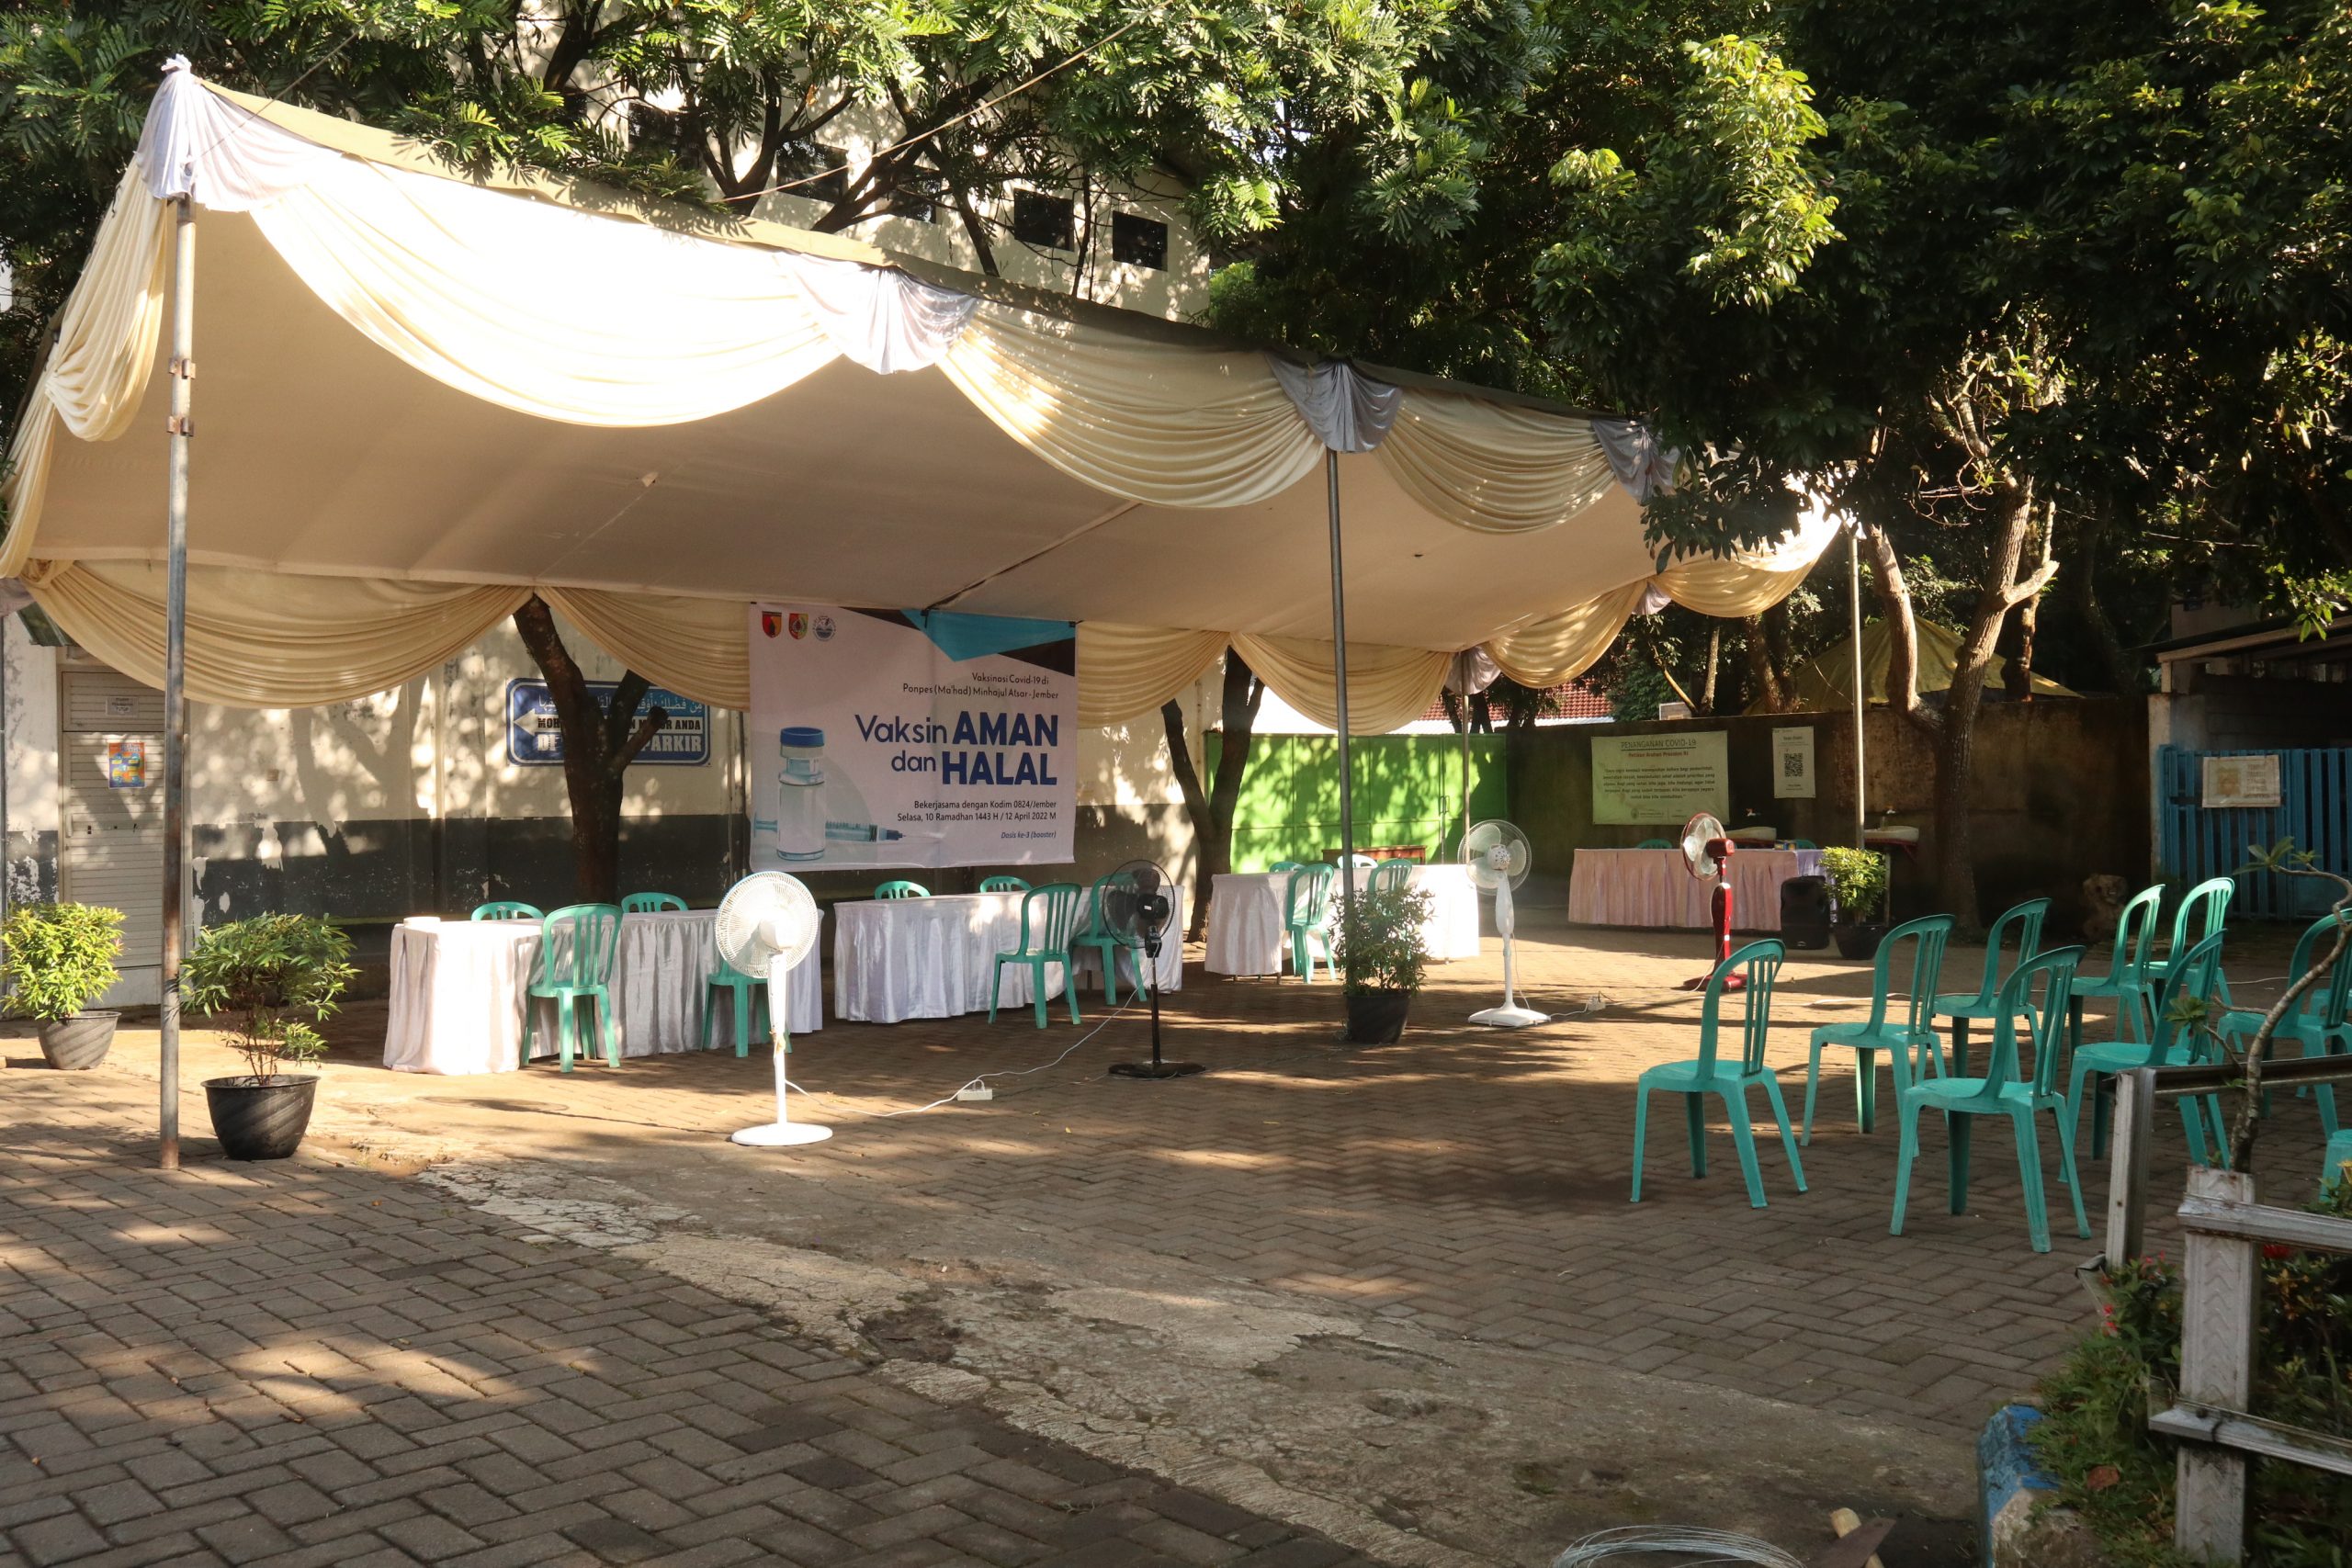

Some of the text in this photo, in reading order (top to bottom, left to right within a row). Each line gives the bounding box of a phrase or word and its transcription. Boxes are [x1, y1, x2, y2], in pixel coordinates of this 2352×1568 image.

[972, 672, 1049, 685] Vaksinasi Covid-19 di
[902, 683, 933, 694] Ponpes
[973, 687, 1007, 698] Minhajul
[1032, 688, 1058, 700] Jember
[674, 719, 701, 730] ANDA
[854, 710, 1058, 747] Vaksin AMAN
[640, 735, 702, 752] ARKIR
[1621, 739, 1697, 749] PENANGANAN COVID-19
[891, 750, 1057, 785] dan HALAL
[914, 800, 1057, 811] Bekerjasama dengan Kodim 0824/Jember
[897, 813, 923, 822] Selasa,
[925, 813, 934, 821] 10
[935, 813, 974, 821] Ramadhan
[975, 812, 991, 821] 1443
[992, 812, 999, 820] H
[1005, 812, 1012, 820] 12
[1013, 812, 1031, 822] April
[1031, 812, 1047, 820] 2022
[1049, 812, 1057, 820] M
[1001, 831, 1016, 840] Dosis
[1031, 831, 1057, 840] (booster)
